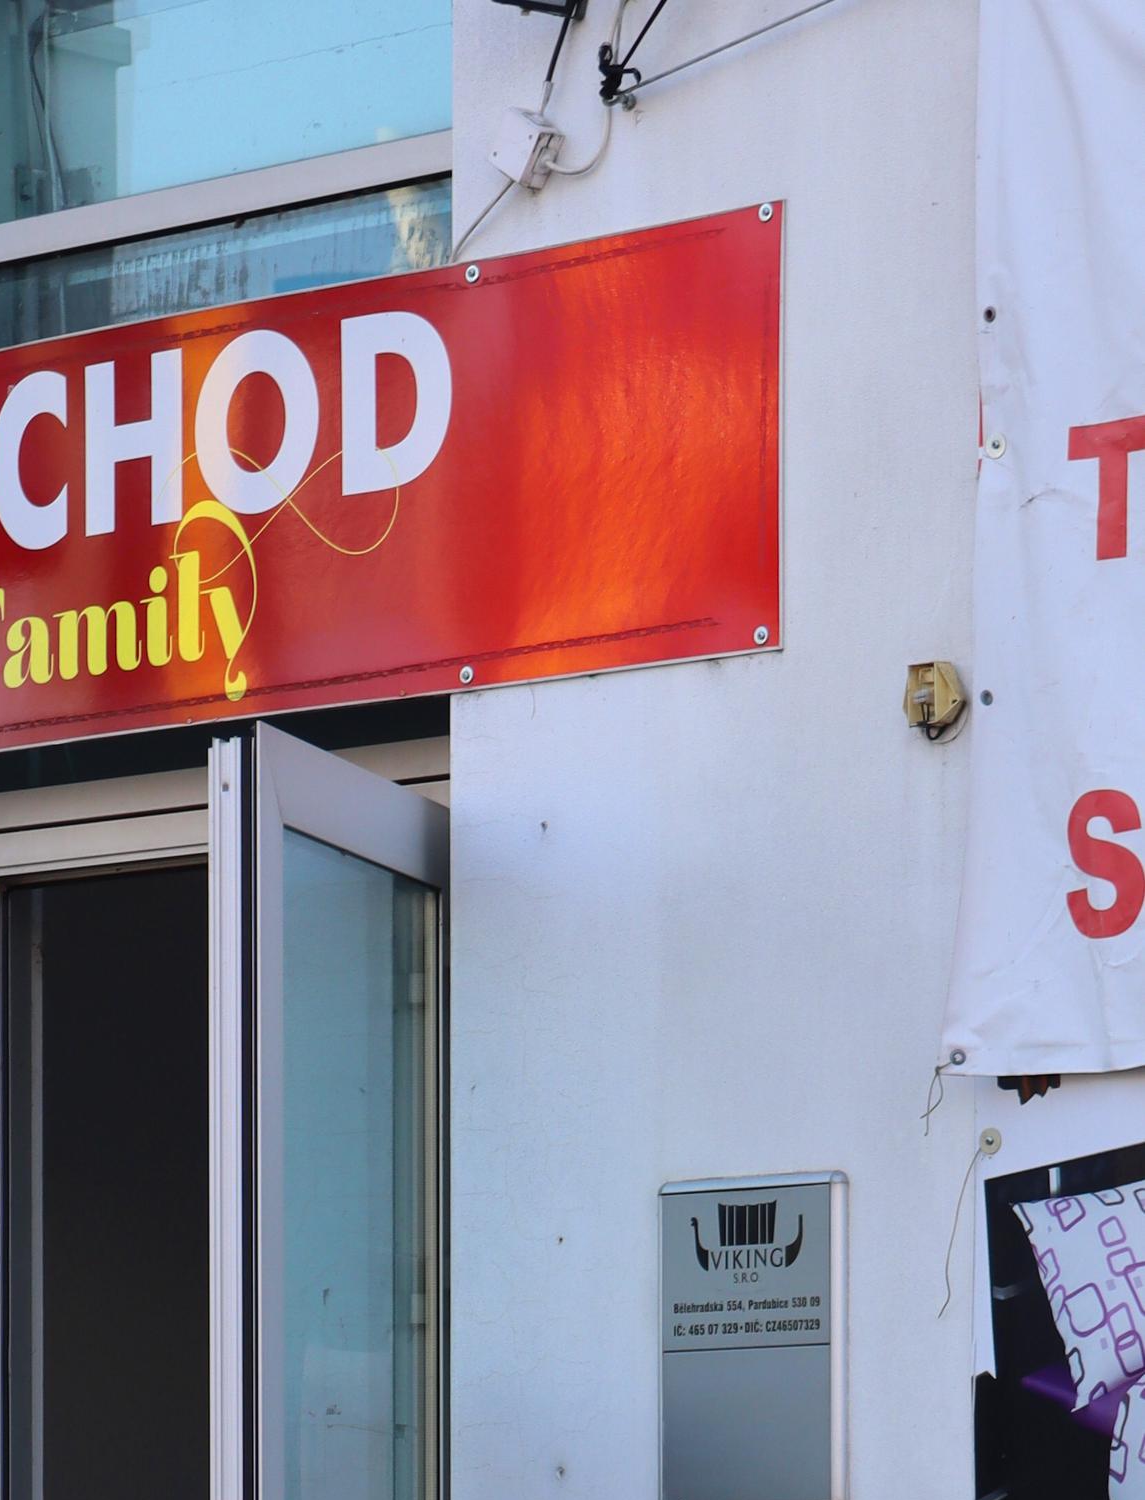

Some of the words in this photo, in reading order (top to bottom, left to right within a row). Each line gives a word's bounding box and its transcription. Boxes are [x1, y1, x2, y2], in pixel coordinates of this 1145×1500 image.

[710, 1247, 784, 1270] VIKING
[748, 1298, 789, 1311] Pardubice
[791, 1297, 807, 1308] 530
[809, 1296, 821, 1307] 09
[688, 1324, 705, 1336] 465
[708, 1323, 718, 1335] 07
[722, 1322, 739, 1334] 329
[765, 1318, 821, 1333] CZ46507329
